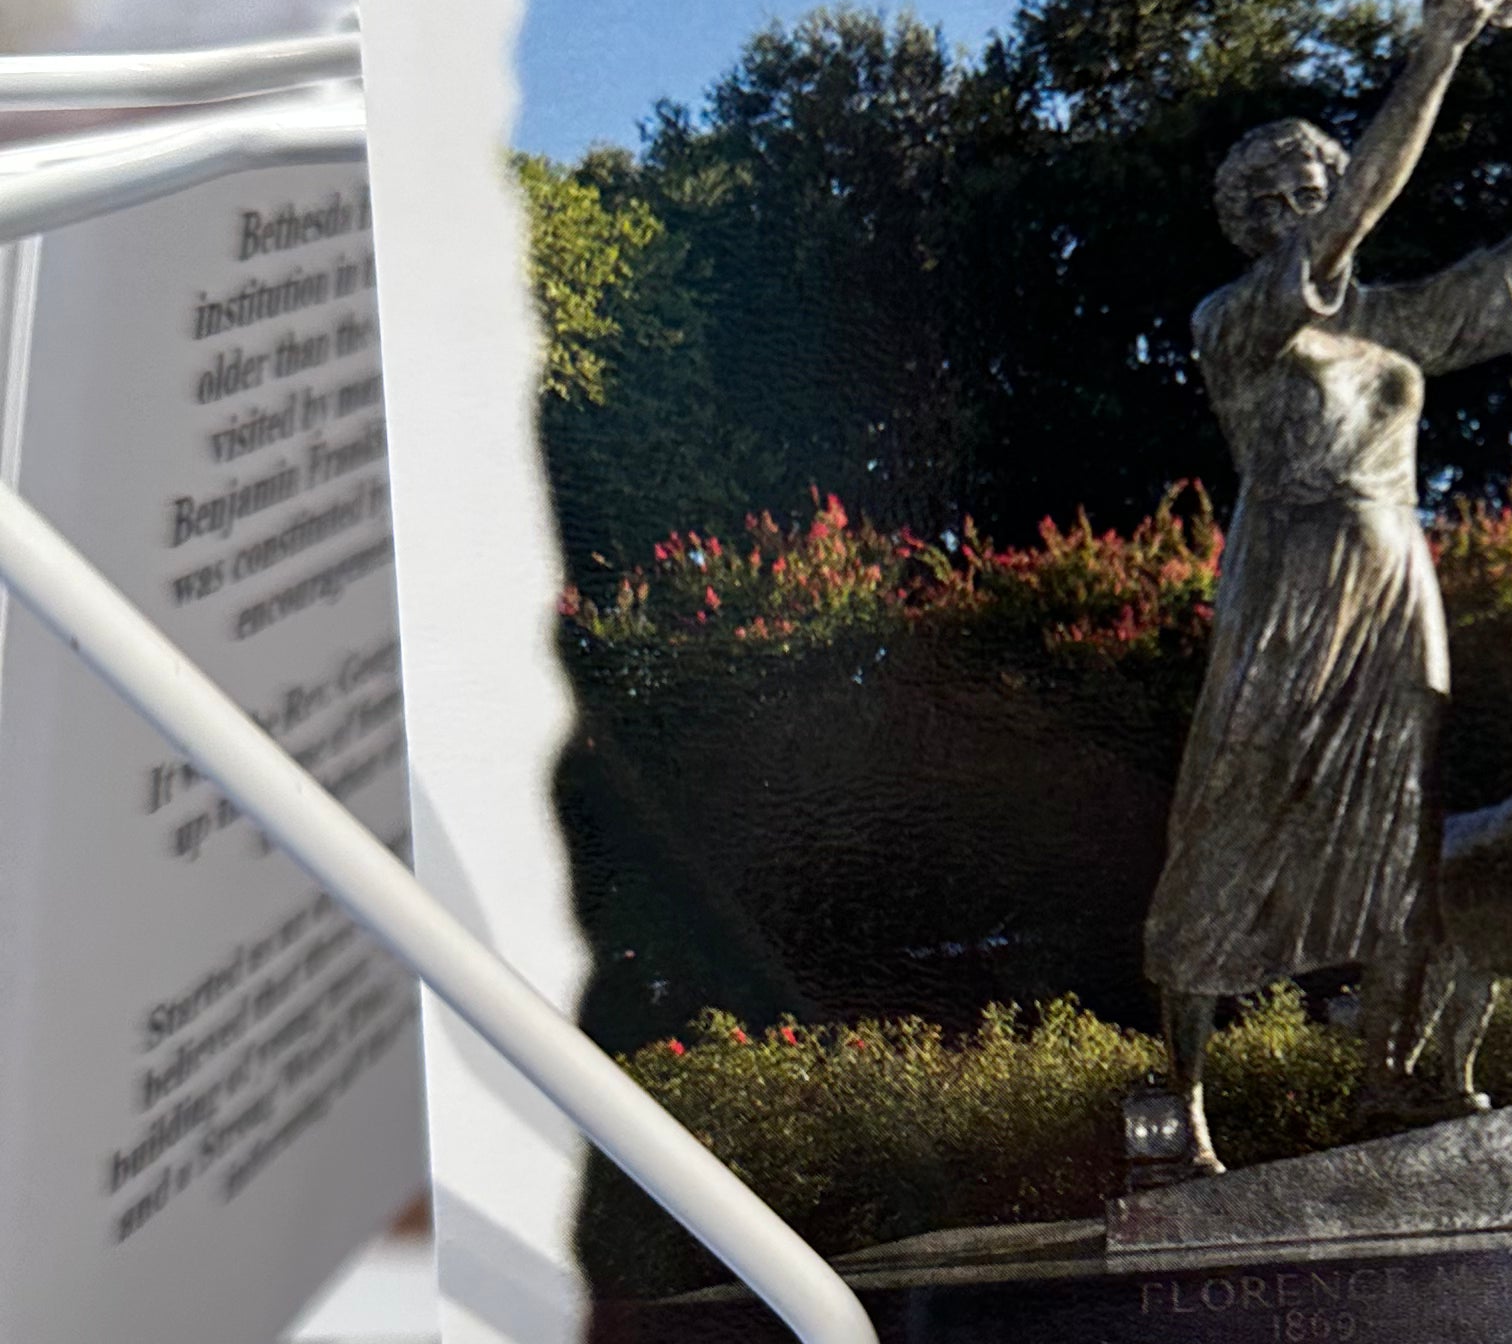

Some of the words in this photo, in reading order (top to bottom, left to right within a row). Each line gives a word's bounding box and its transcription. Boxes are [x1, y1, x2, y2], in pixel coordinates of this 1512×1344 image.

[192, 261, 329, 342] institution
[194, 346, 268, 407] older
[167, 458, 301, 549] Benjamin
